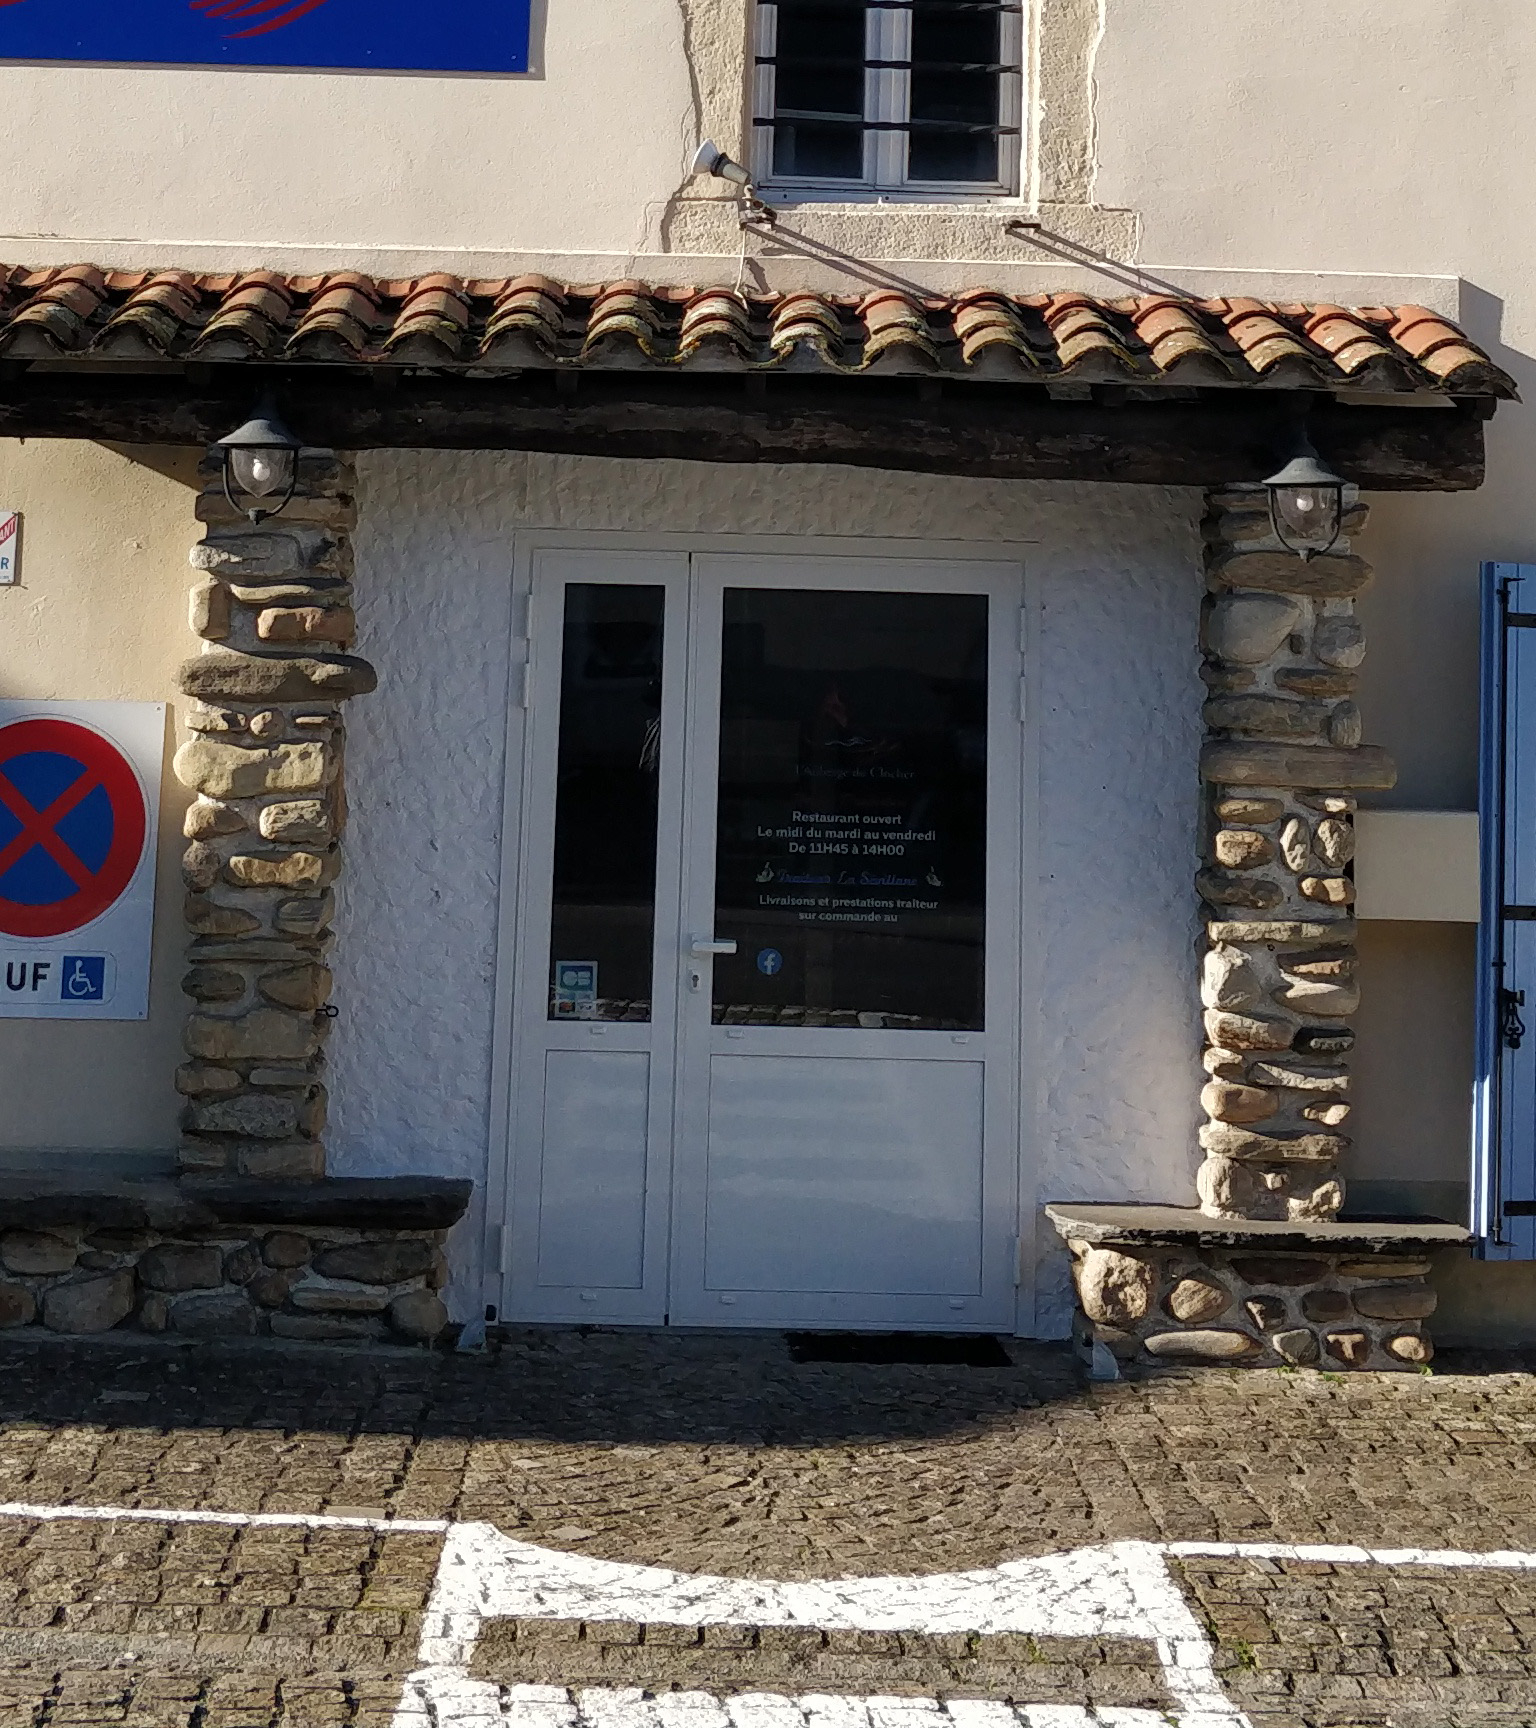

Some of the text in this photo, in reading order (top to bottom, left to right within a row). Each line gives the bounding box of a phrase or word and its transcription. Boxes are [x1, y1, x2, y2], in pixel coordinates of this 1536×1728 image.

[792, 810, 902, 825] Restaurant ouvert
[757, 826, 936, 842] Le midi du mardi au vendredi
[789, 842, 806, 854] De
[809, 843, 849, 854] 11H45
[862, 844, 904, 856] 14H00
[759, 895, 939, 910] Livraisons et prestations traiteur
[798, 911, 898, 922] sur commande au
